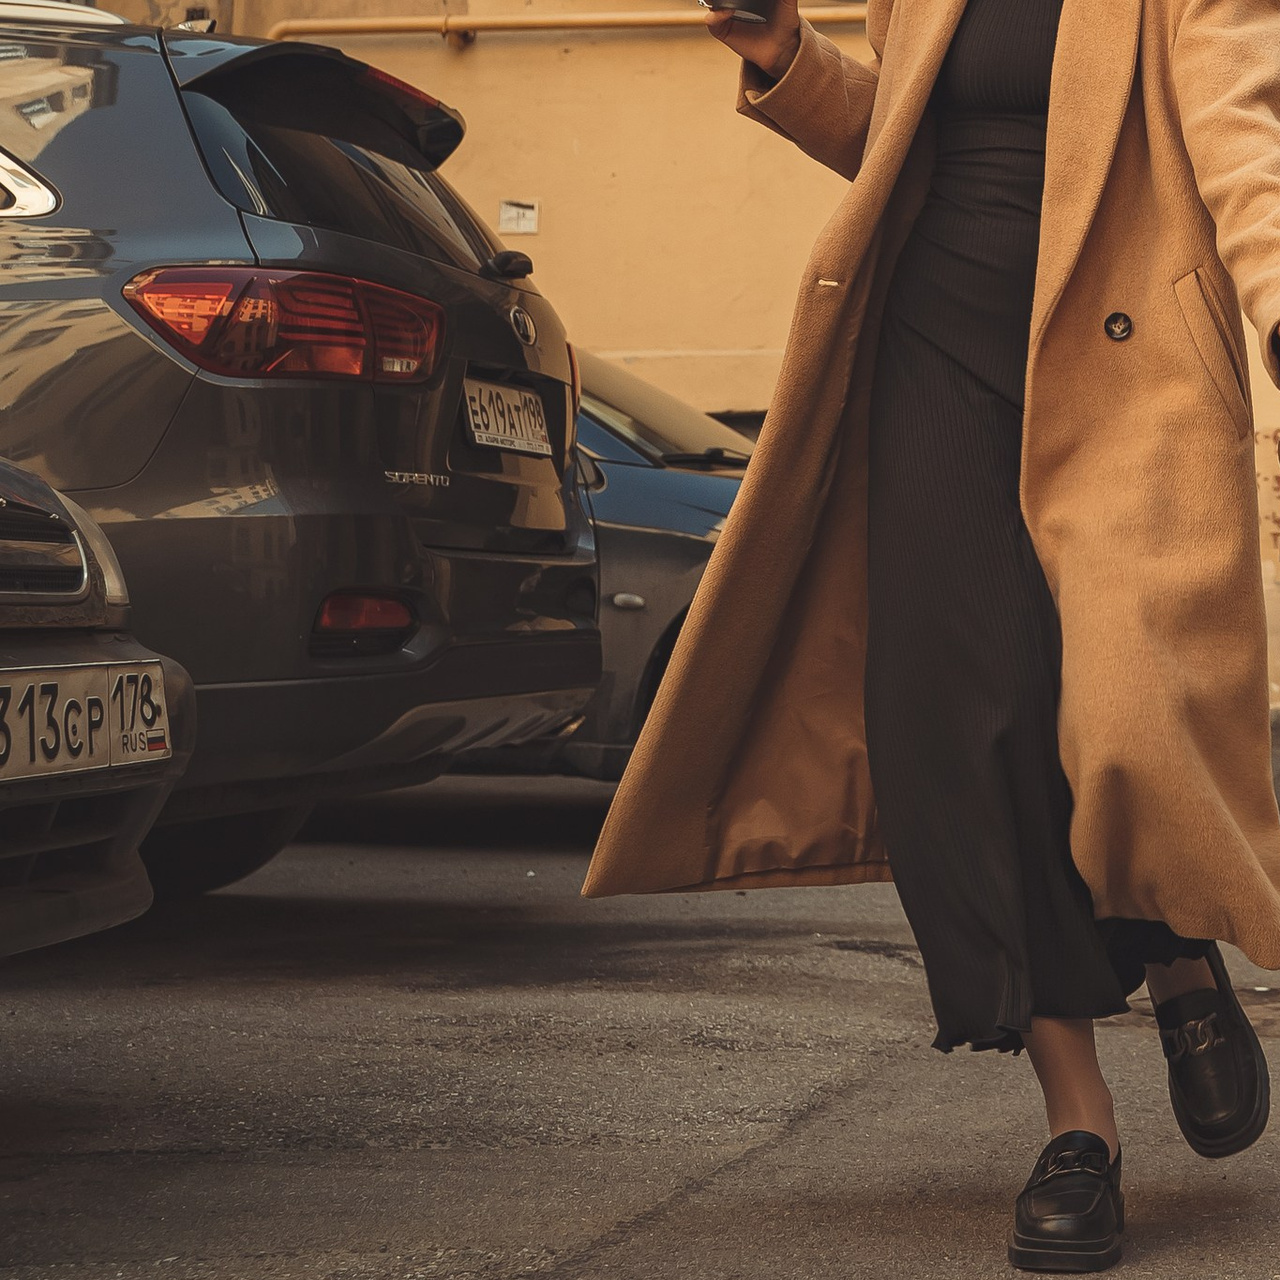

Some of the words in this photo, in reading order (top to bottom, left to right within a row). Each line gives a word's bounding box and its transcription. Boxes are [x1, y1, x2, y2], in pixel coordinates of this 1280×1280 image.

[523, 395, 545, 431] 198
[384, 470, 450, 487] SORENTO
[111, 673, 157, 732] 178
[121, 732, 147, 754] RUS
